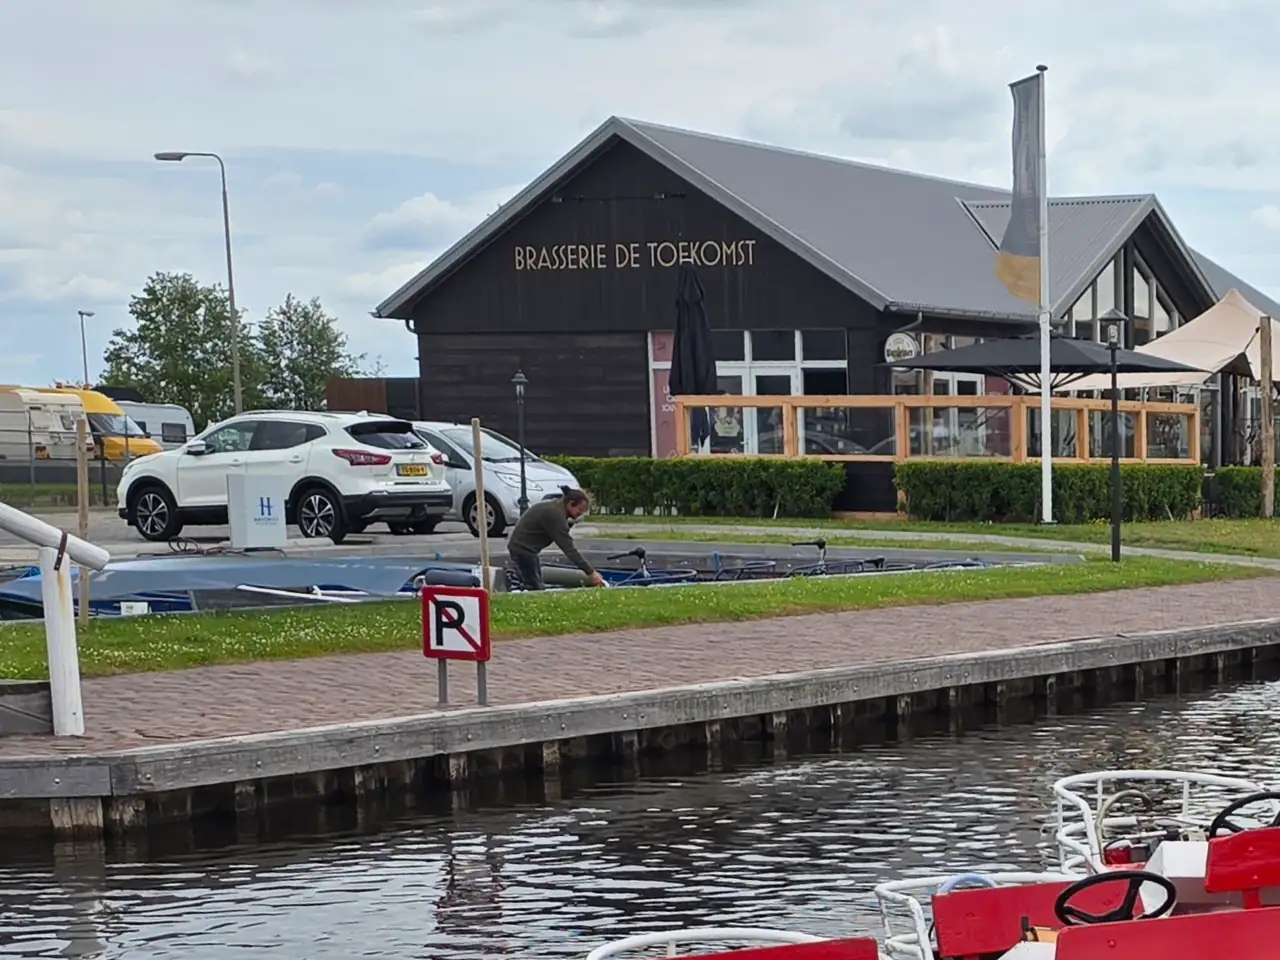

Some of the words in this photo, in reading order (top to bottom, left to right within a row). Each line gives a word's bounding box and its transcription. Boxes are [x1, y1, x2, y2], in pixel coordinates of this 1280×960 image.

[515, 244, 607, 270] BRASSERIE
[615, 243, 640, 268] DE
[647, 240, 756, 267] TOEKOMST
[435, 600, 465, 646] P
